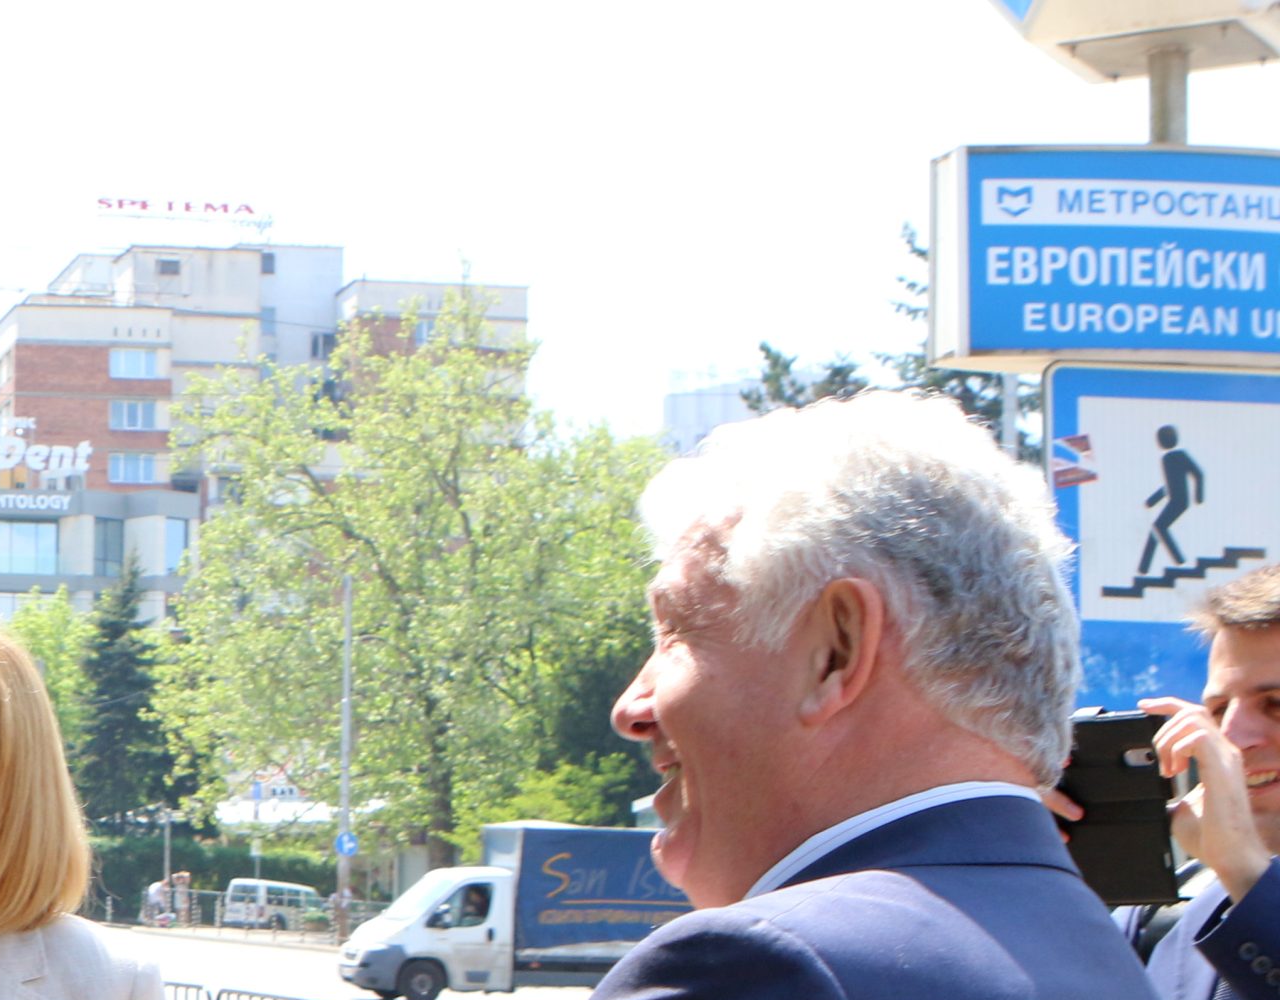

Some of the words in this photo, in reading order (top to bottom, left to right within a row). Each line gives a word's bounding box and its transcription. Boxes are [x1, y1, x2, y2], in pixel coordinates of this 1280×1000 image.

[986, 242, 1266, 292] ЕВРОПЕЙСКИ
[1023, 302, 1238, 336] EUROPEAN
[542, 852, 607, 898] San
